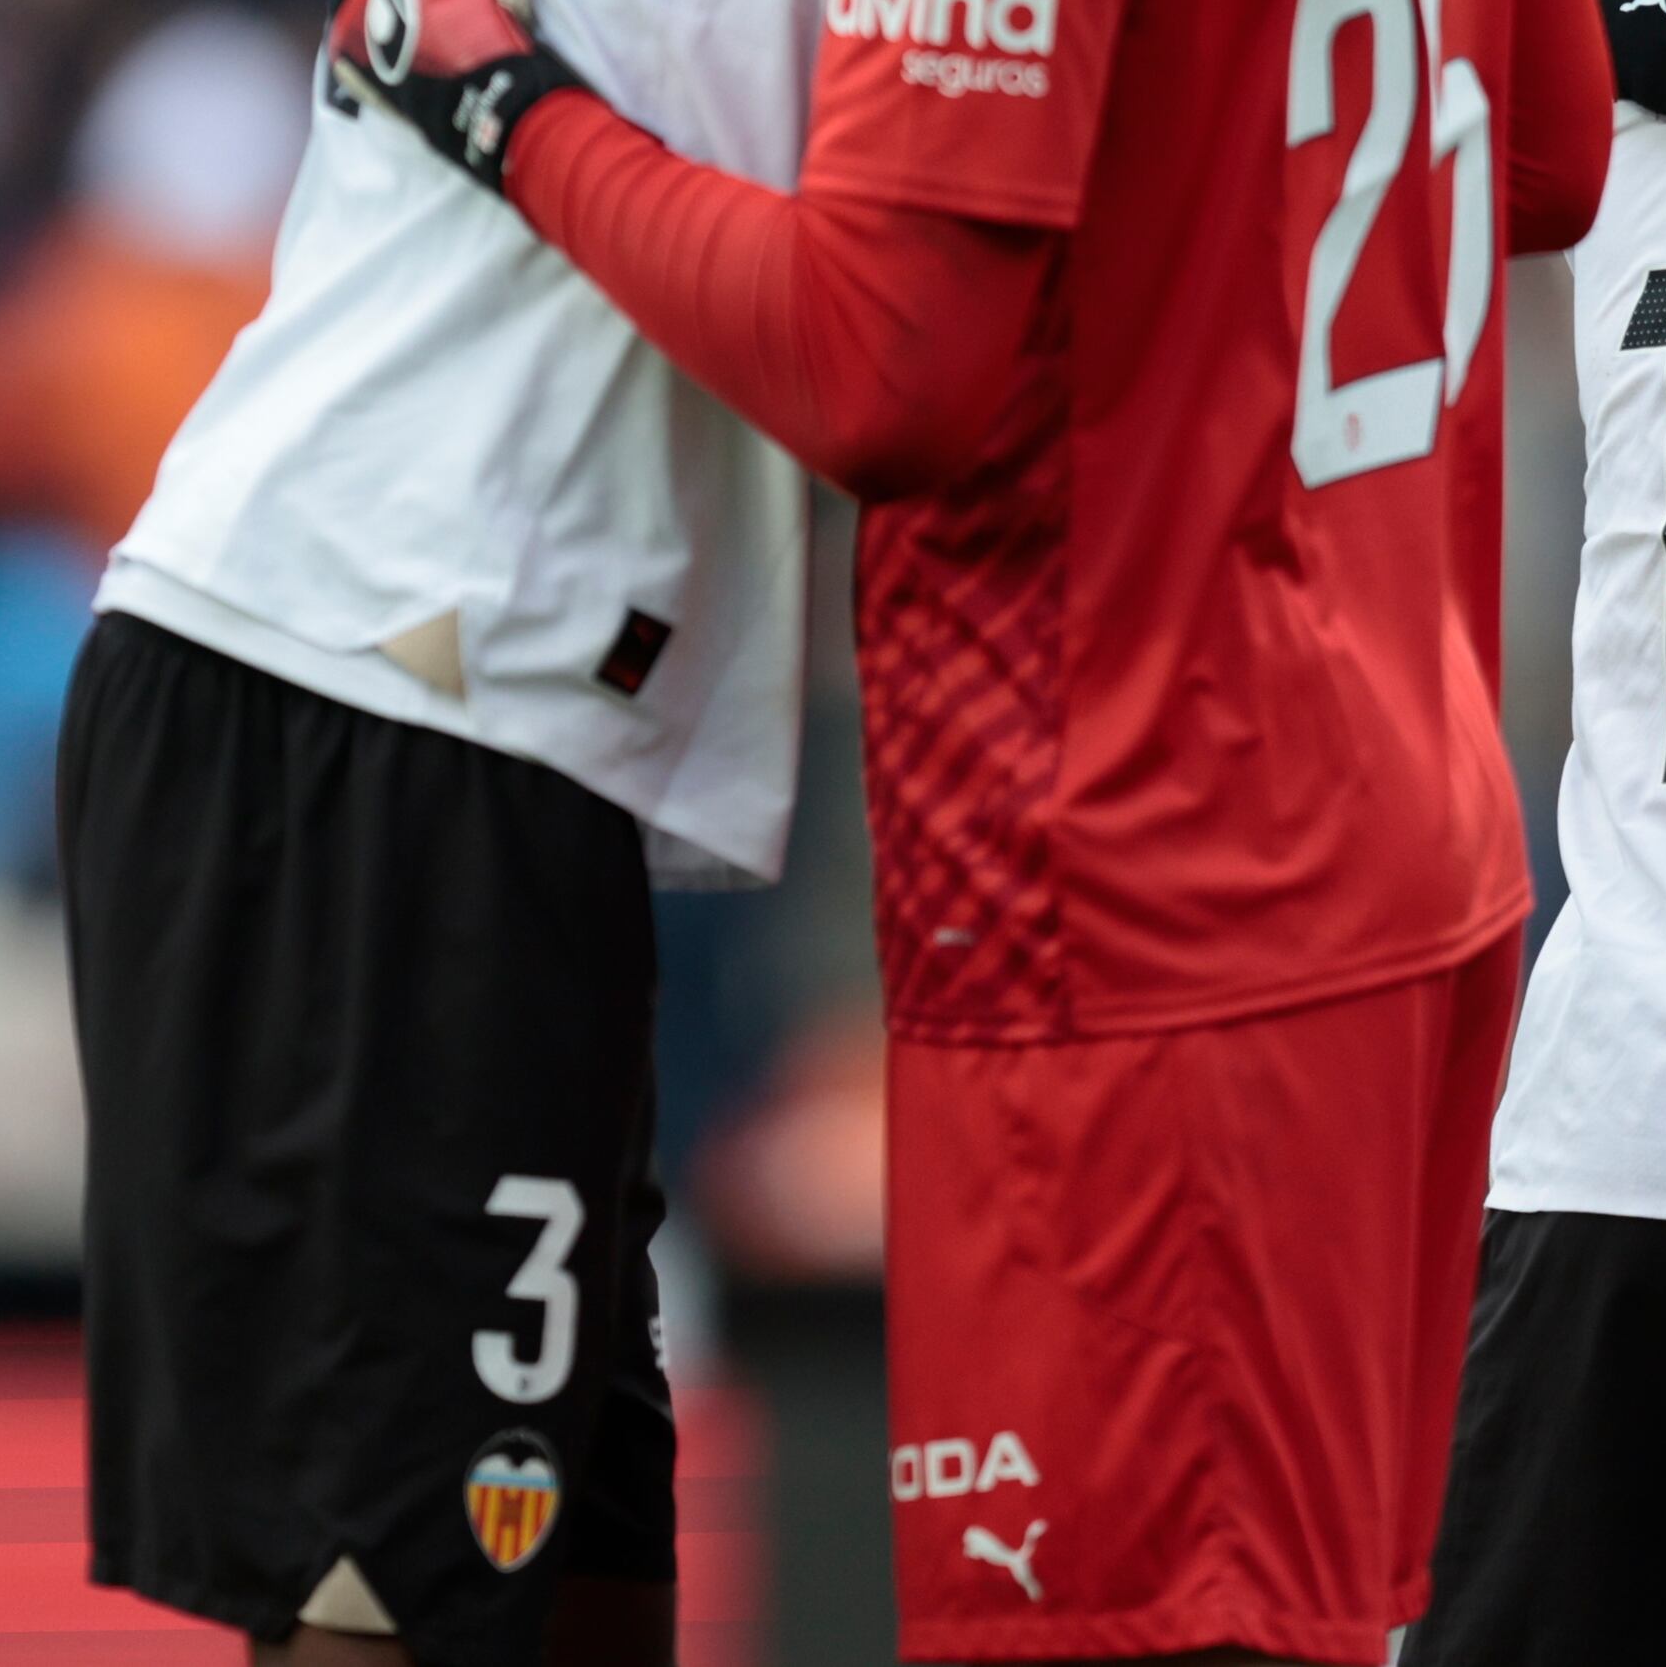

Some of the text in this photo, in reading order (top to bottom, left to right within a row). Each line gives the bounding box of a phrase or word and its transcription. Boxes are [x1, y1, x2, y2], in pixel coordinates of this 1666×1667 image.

[901, 48, 1050, 99] seguros
[471, 1174, 585, 1404] 3
[890, 1430, 1041, 1503] ODA
